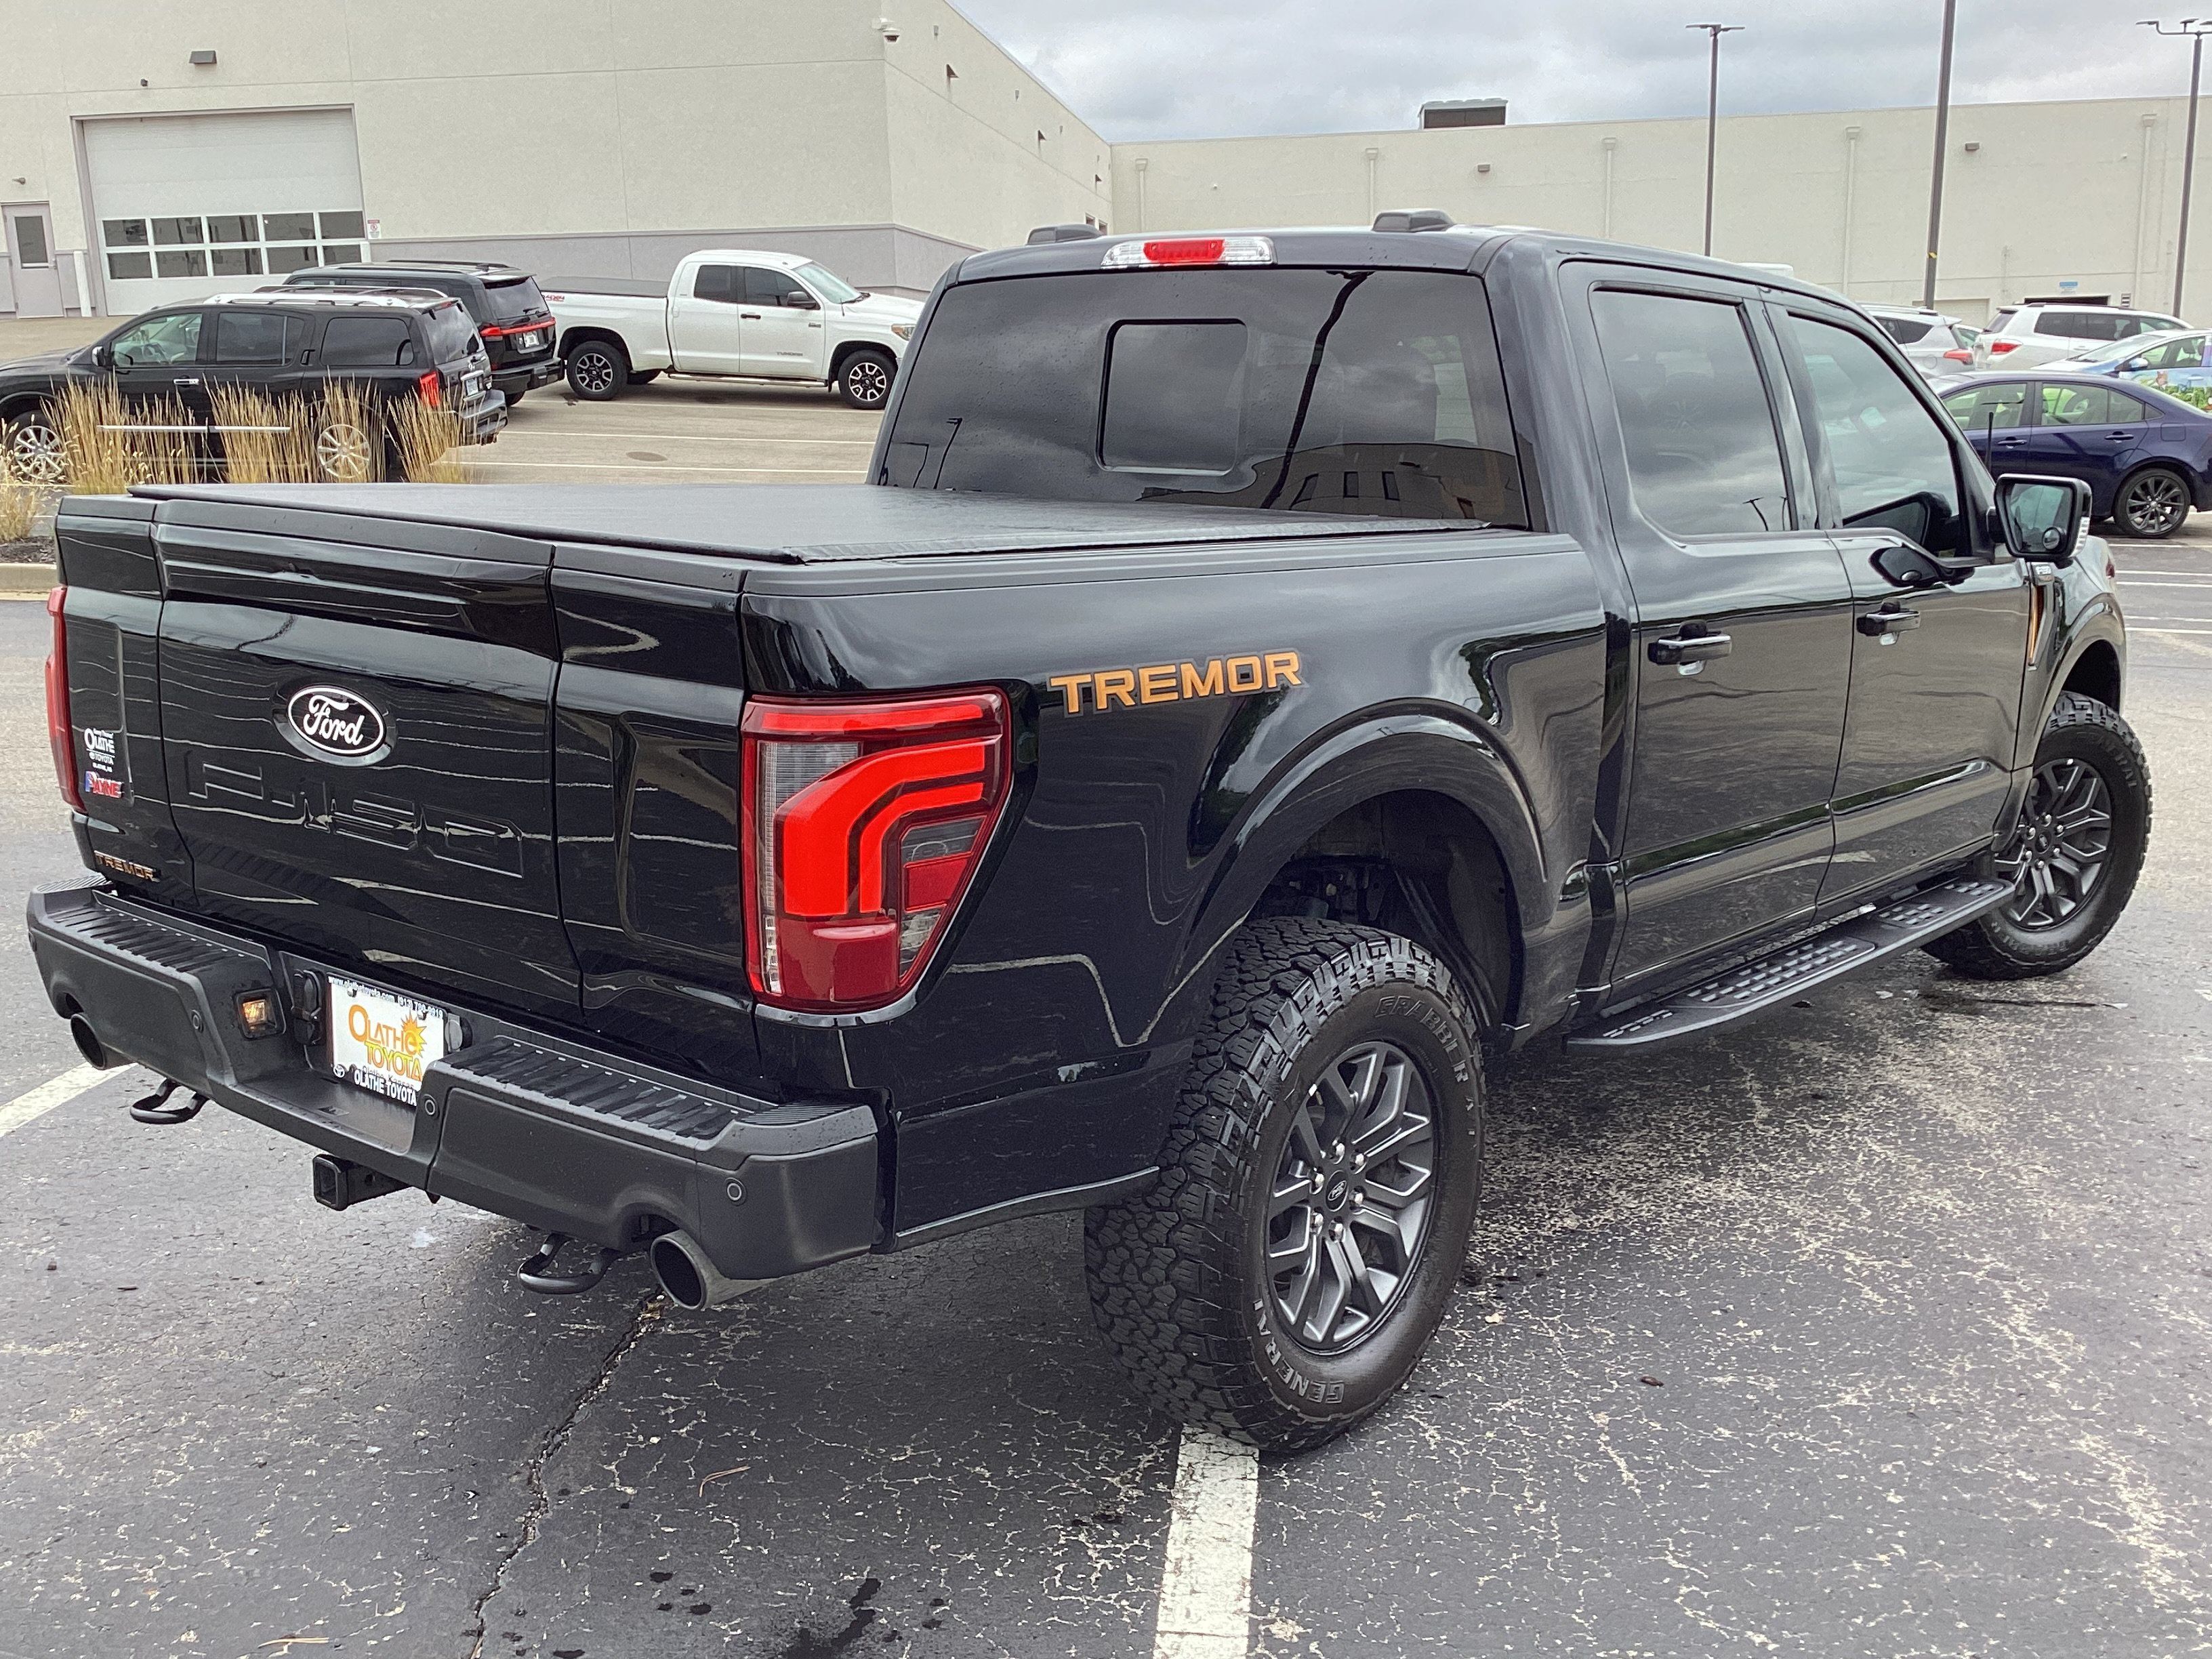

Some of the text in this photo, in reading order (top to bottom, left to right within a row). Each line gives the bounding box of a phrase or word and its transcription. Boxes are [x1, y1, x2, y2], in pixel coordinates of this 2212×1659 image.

[1048, 649, 1307, 716] TREMOR
[303, 694, 365, 746] Ford
[85, 771, 123, 799] PAYNE
[96, 851, 159, 882] TREMOR
[398, 995, 413, 1009] (913)
[1375, 994, 1469, 1082] GRABBER
[365, 1040, 422, 1082] TOYOTA
[354, 1069, 417, 1107] OLATHE TOYOTA
[1253, 1298, 1345, 1404] GENERAL
